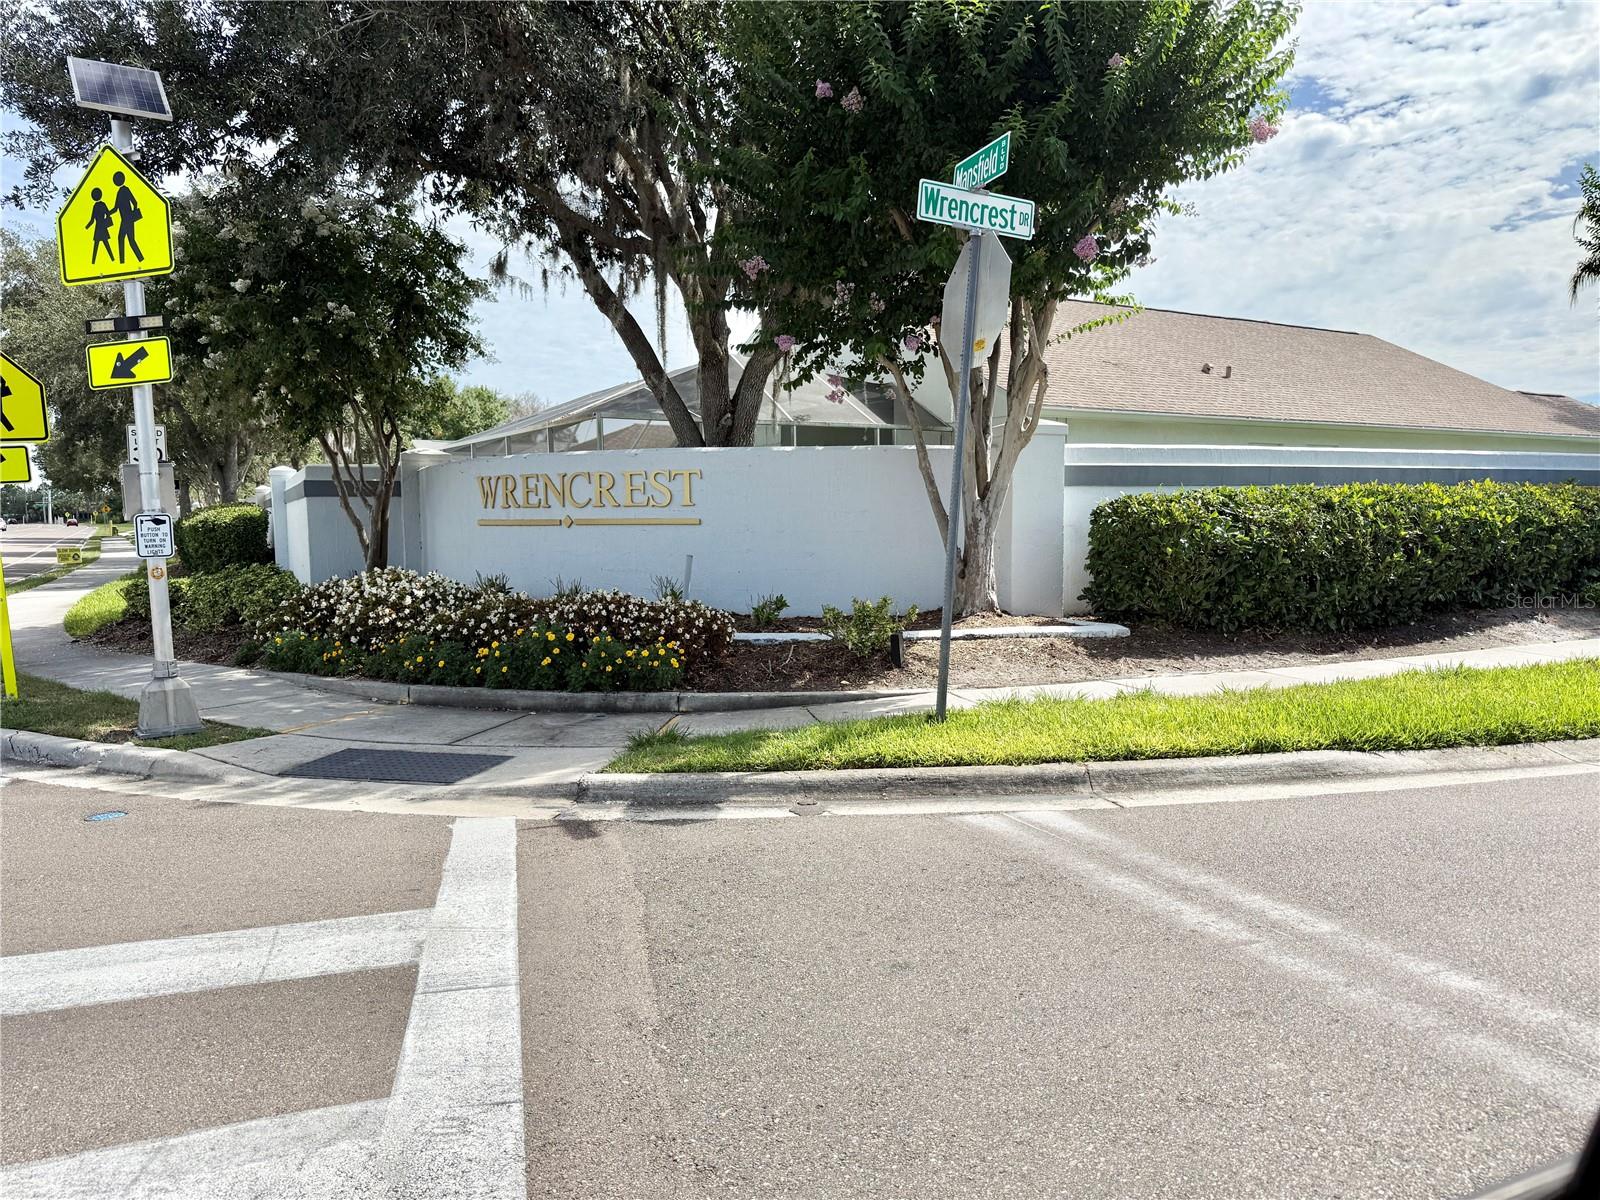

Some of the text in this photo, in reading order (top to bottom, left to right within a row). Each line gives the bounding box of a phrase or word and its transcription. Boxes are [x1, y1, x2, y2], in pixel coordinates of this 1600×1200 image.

[955, 145, 999, 189] Mansfield
[924, 185, 1030, 231] Wrencrest DR
[477, 469, 702, 510] WRENCREST
